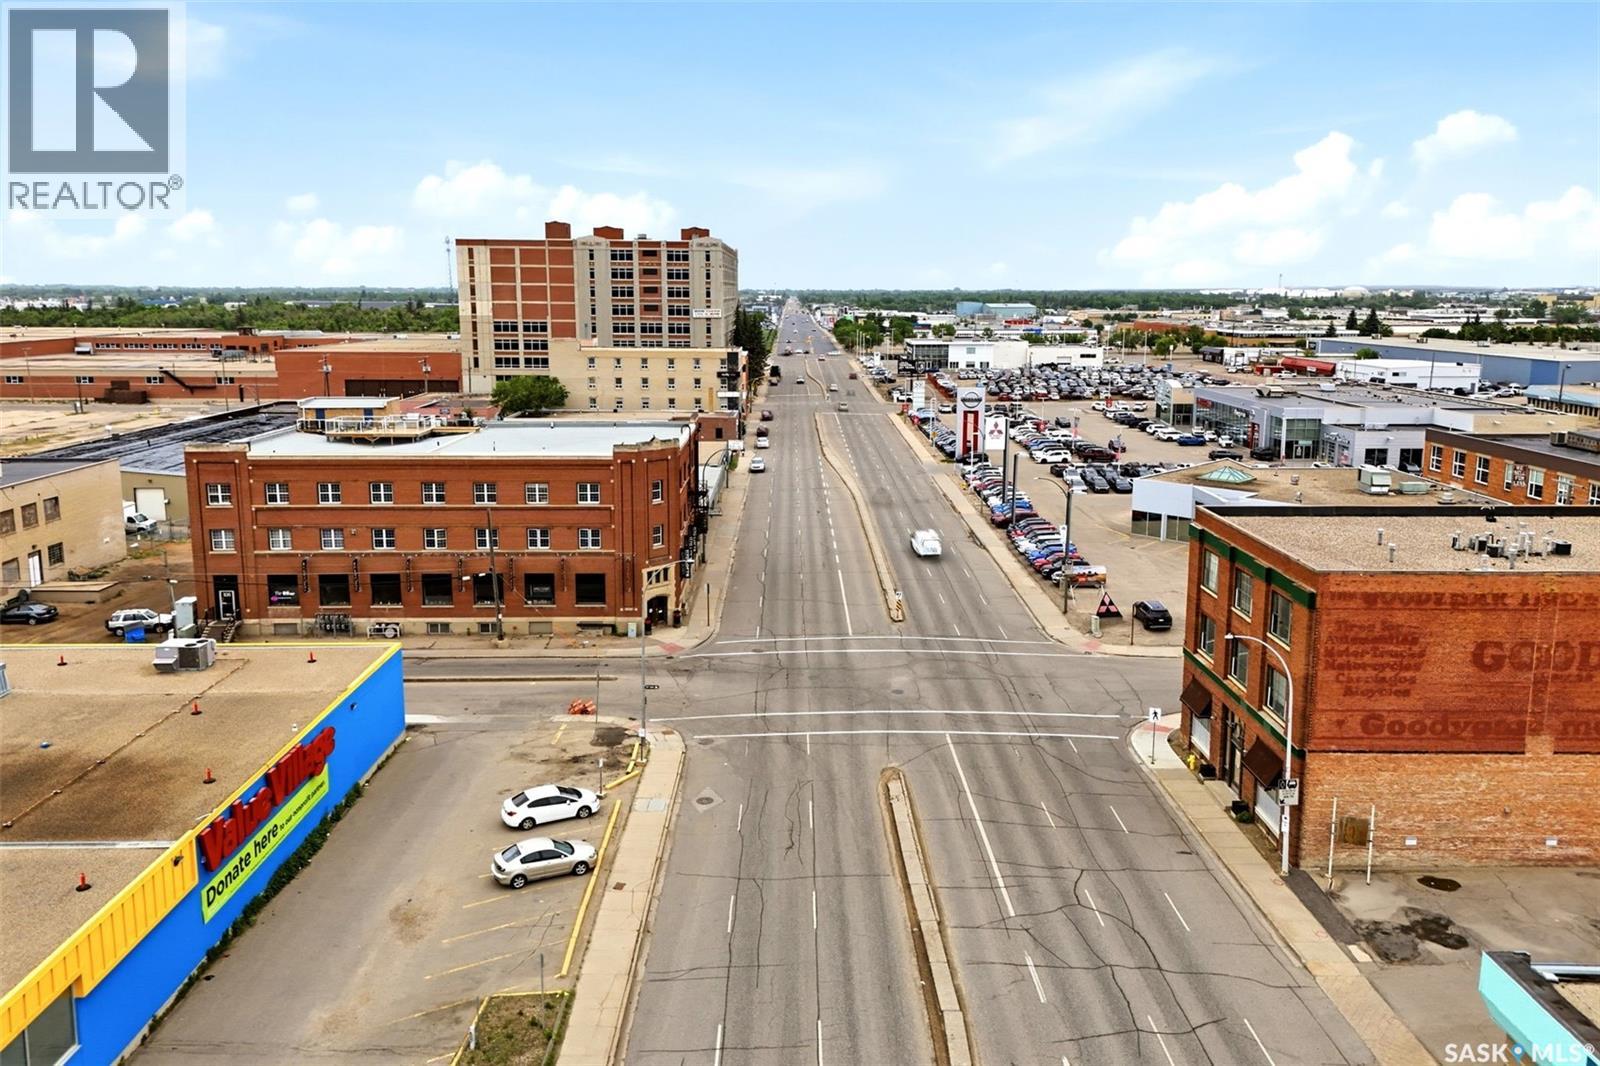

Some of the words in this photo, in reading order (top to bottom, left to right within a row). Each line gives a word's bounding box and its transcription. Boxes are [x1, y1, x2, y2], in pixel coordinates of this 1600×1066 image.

[199, 786, 272, 872] Value
[266, 726, 335, 806] Village
[206, 852, 251, 907] Donate
[253, 824, 278, 857] here
